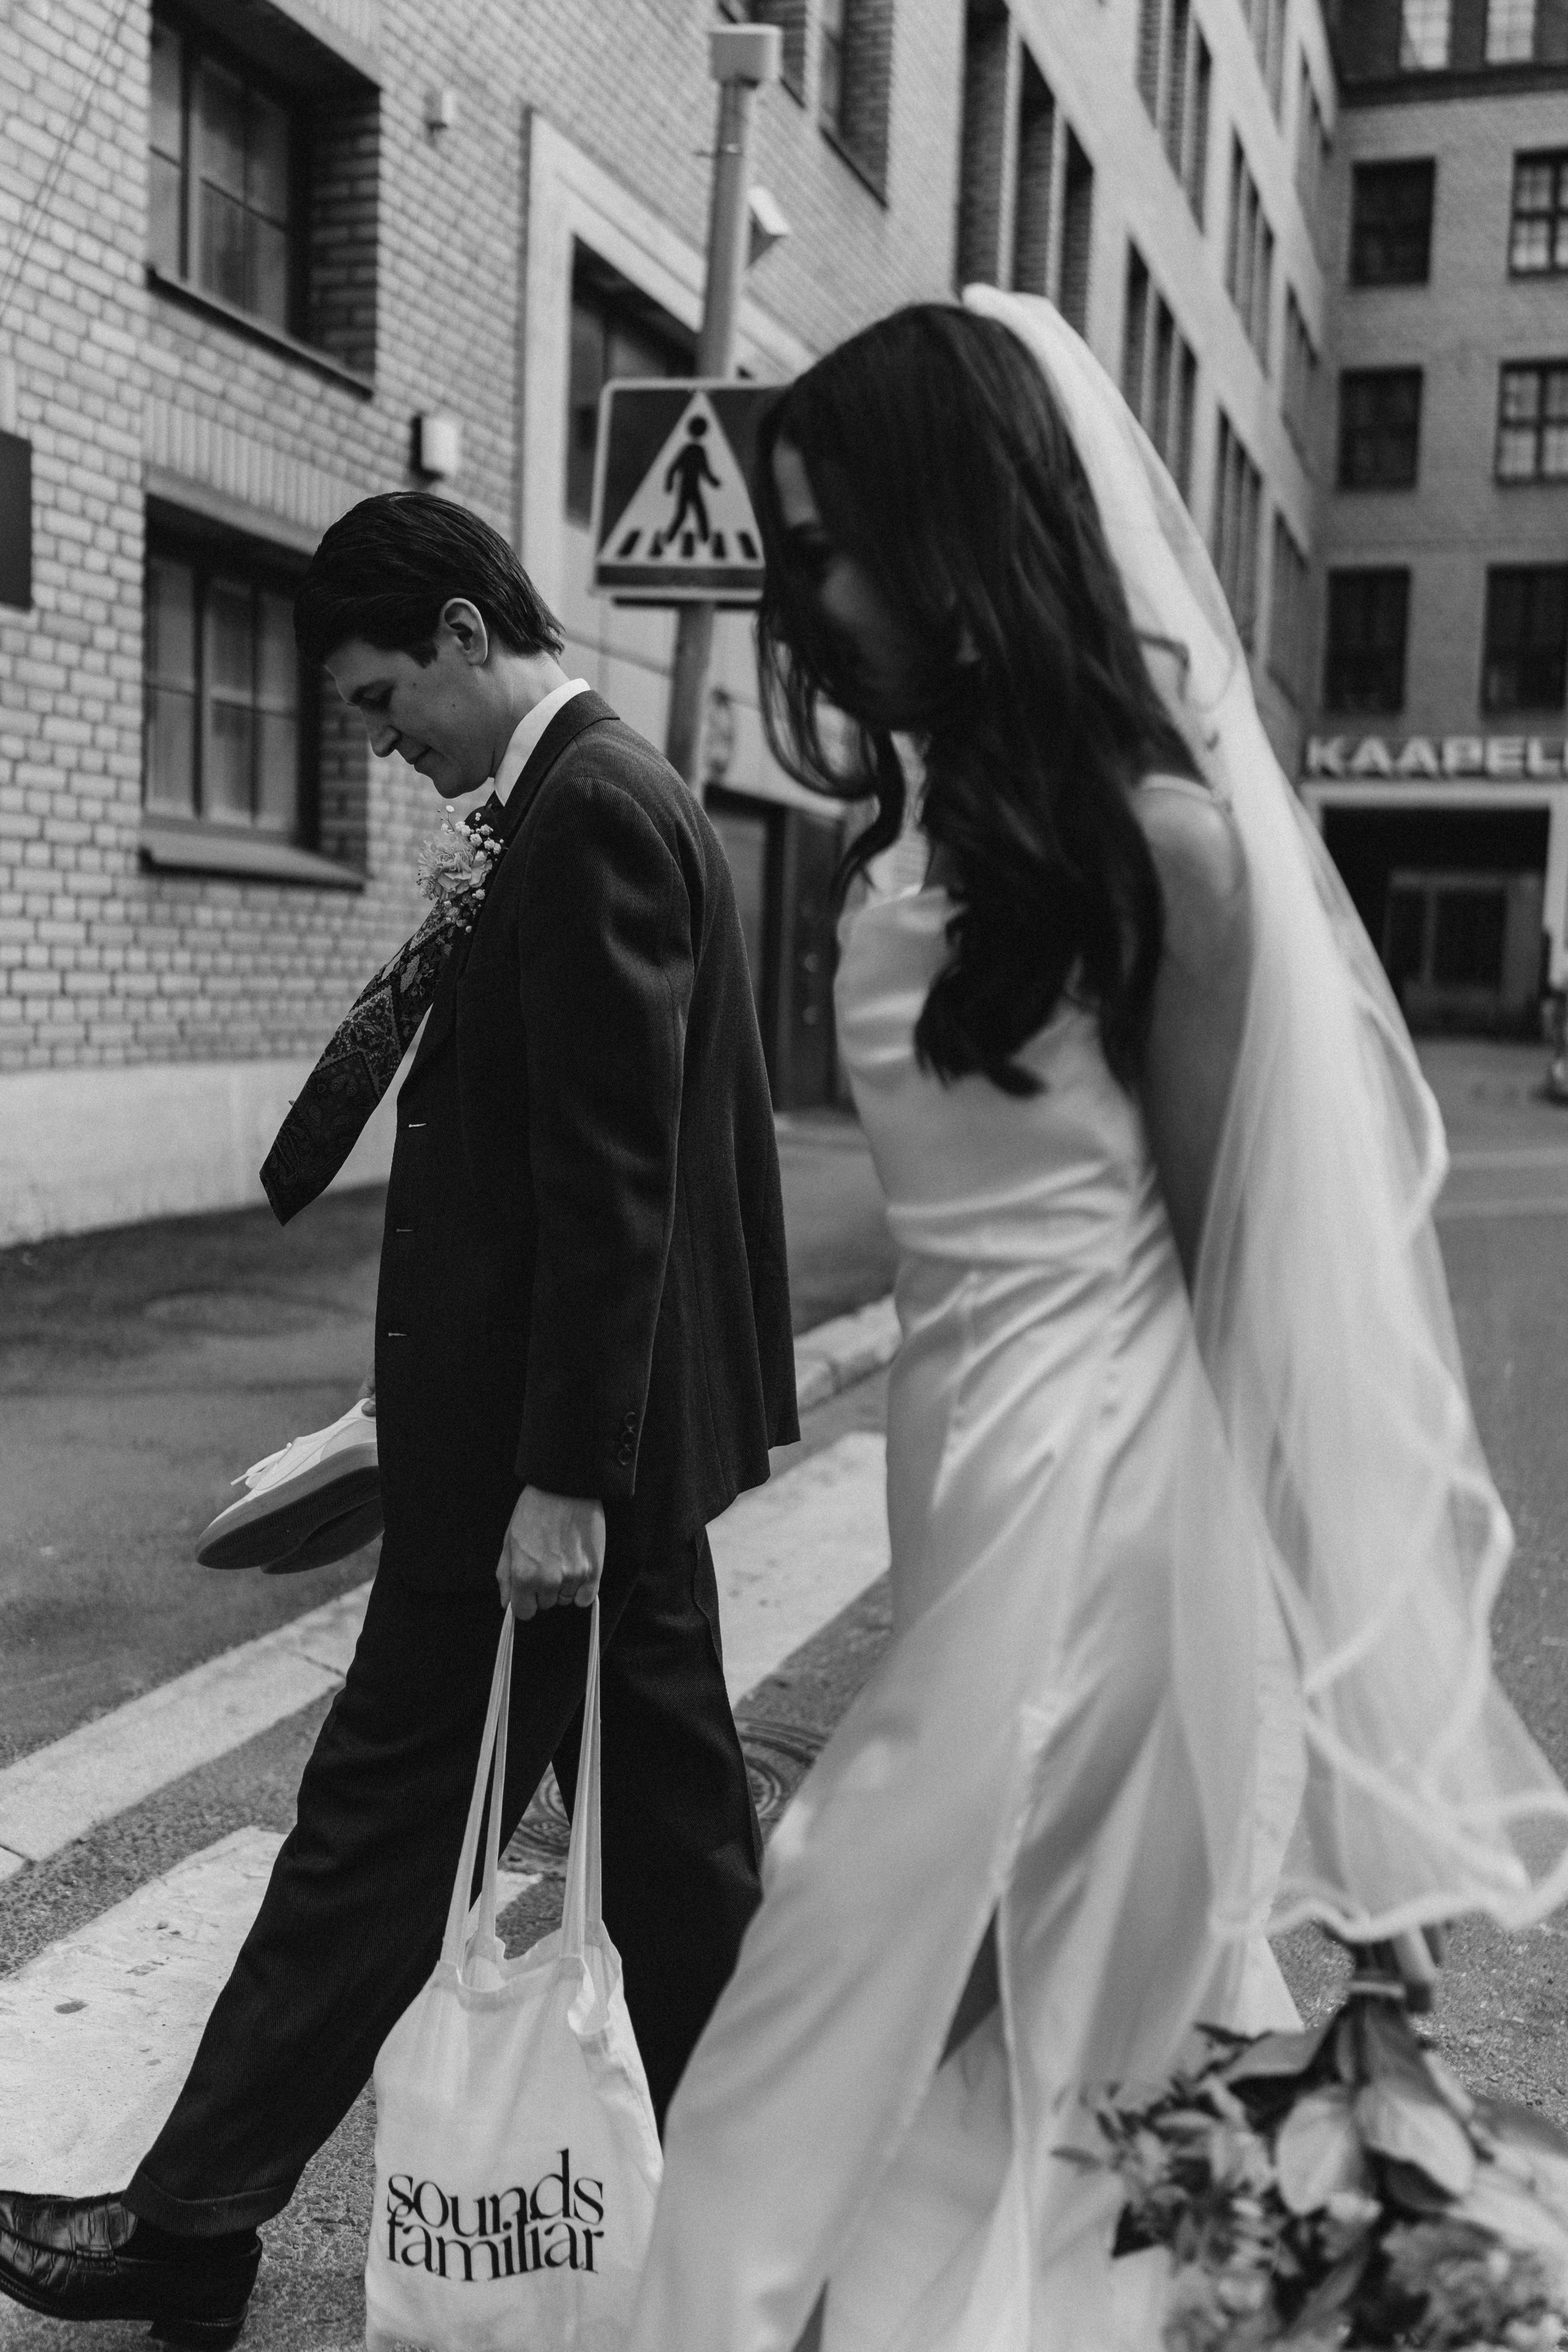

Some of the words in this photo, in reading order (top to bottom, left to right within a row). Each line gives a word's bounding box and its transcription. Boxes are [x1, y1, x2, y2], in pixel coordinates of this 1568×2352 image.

[1305, 734, 1568, 774] KAAPEL
[386, 2147, 603, 2237] sounds
[387, 2204, 604, 2282] familiar
